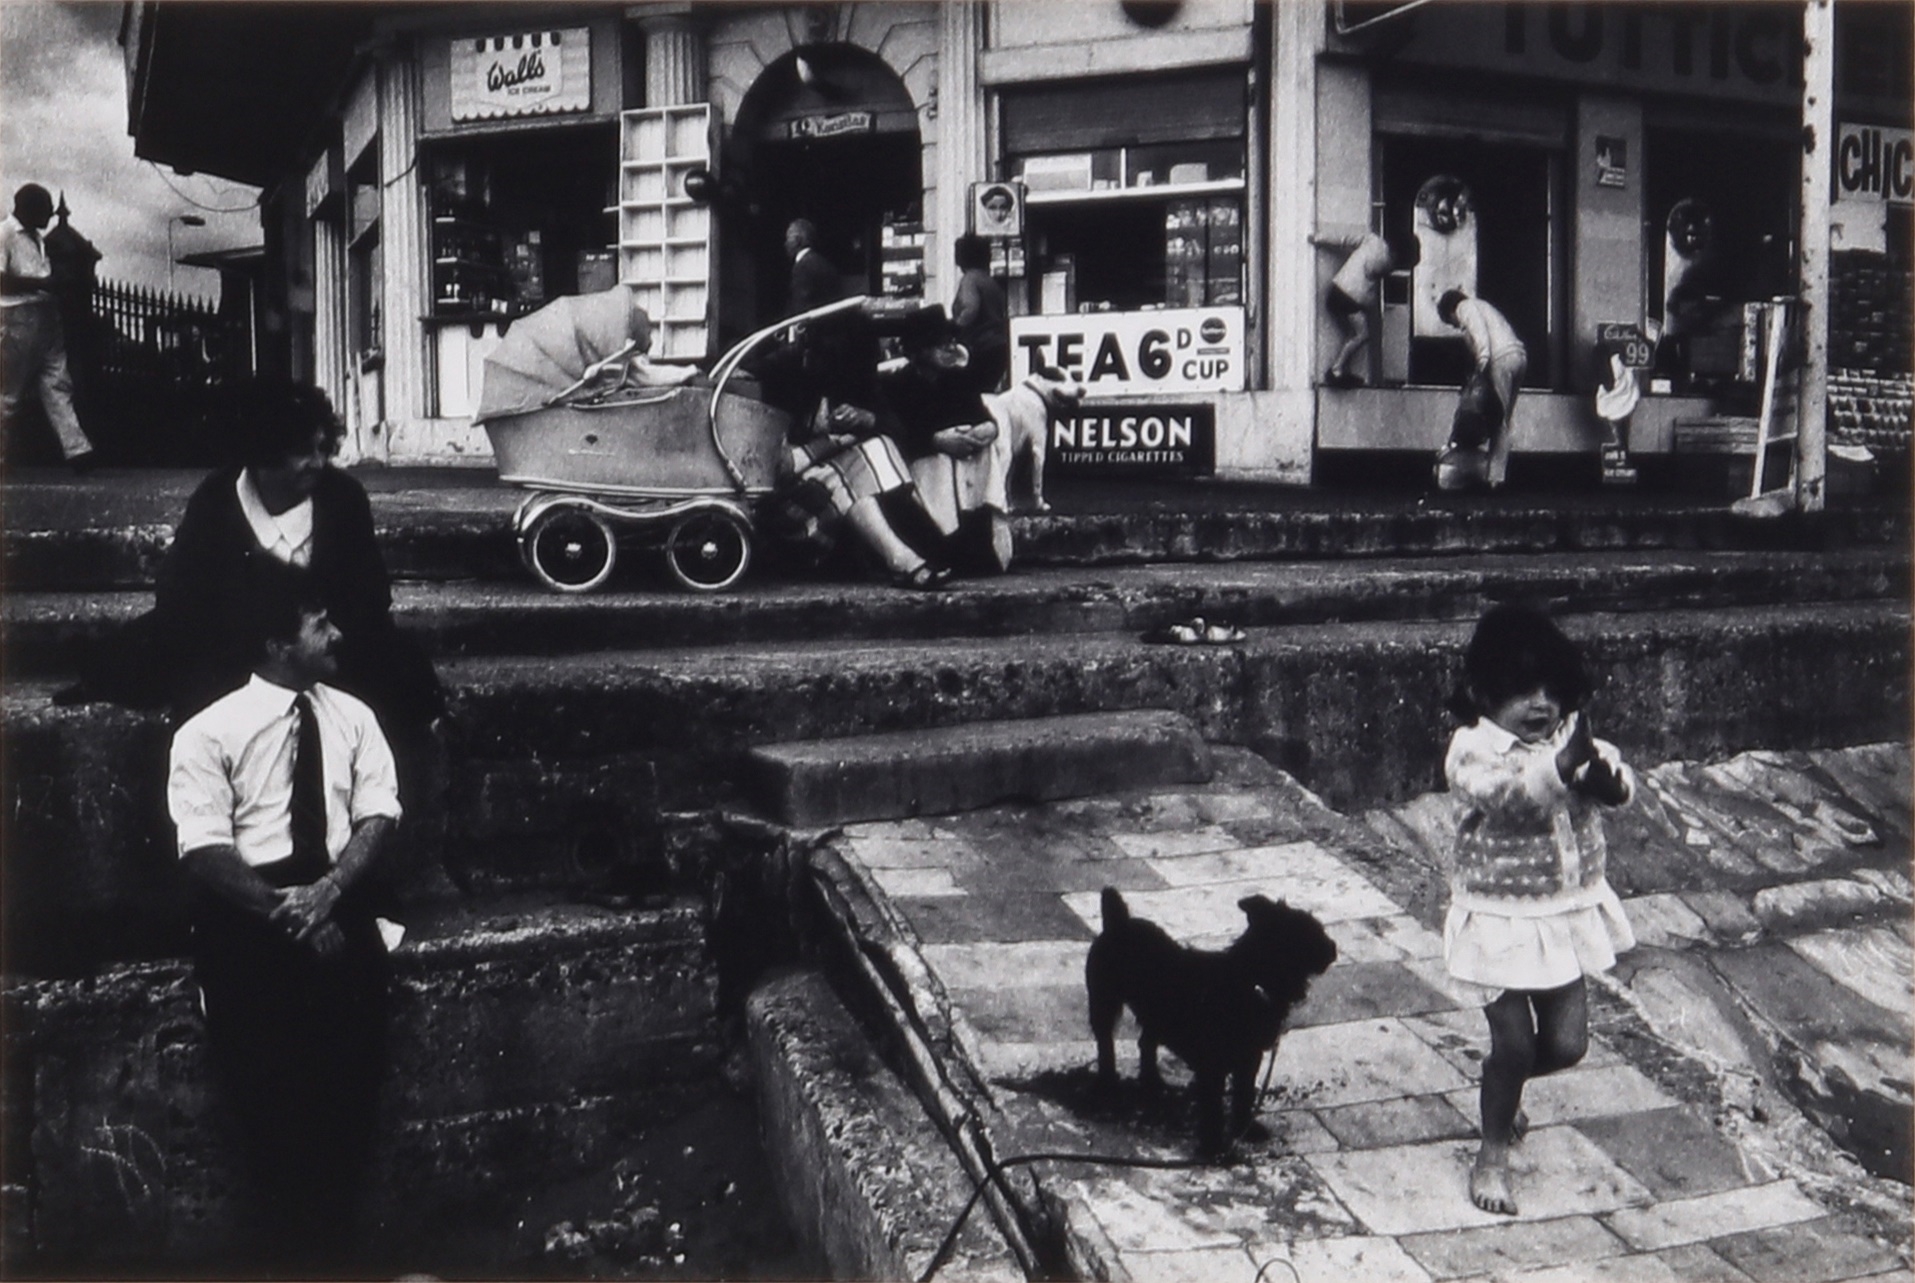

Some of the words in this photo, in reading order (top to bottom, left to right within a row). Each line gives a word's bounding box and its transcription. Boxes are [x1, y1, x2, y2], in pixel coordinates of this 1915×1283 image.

[507, 86, 520, 95] ICE
[522, 85, 551, 94] CREAM
[1840, 128, 1914, 200] CHIC
[1018, 333, 1130, 382] TEA
[1626, 342, 1649, 365] 99
[1182, 359, 1229, 380] CUP
[1054, 416, 1192, 448] NELSON
[1062, 451, 1104, 463] TIPPED
[1107, 450, 1184, 463] CIGARETTES
